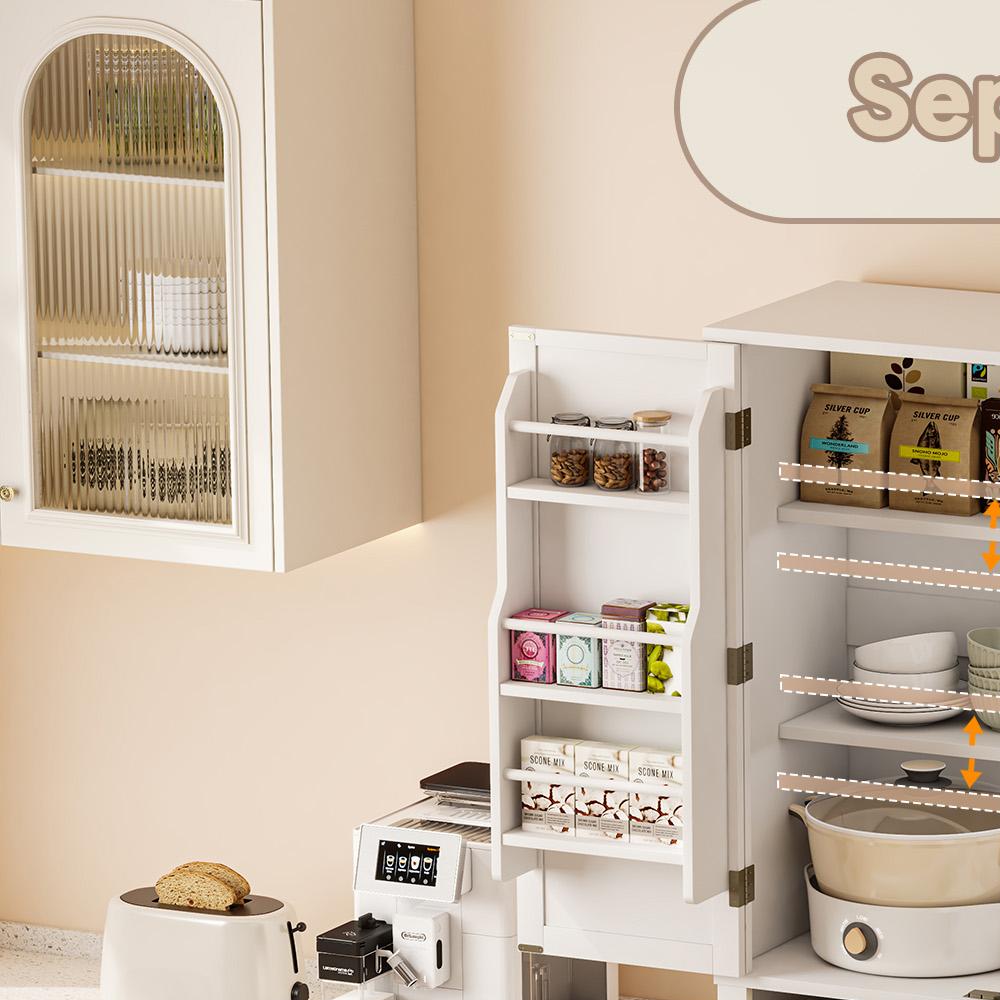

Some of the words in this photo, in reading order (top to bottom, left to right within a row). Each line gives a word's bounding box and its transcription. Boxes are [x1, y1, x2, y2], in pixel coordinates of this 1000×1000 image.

[824, 403, 852, 414] SILVER
[853, 406, 871, 415] CUP
[912, 410, 941, 421] SILVER
[943, 413, 961, 422] CUP
[529, 755, 552, 766] SCONE
[552, 757, 566, 767] MIX
[583, 761, 605, 772] SCONE
[606, 763, 620, 773] MIX
[637, 766, 660, 778] SCONE
[661, 769, 674, 779] MIX
